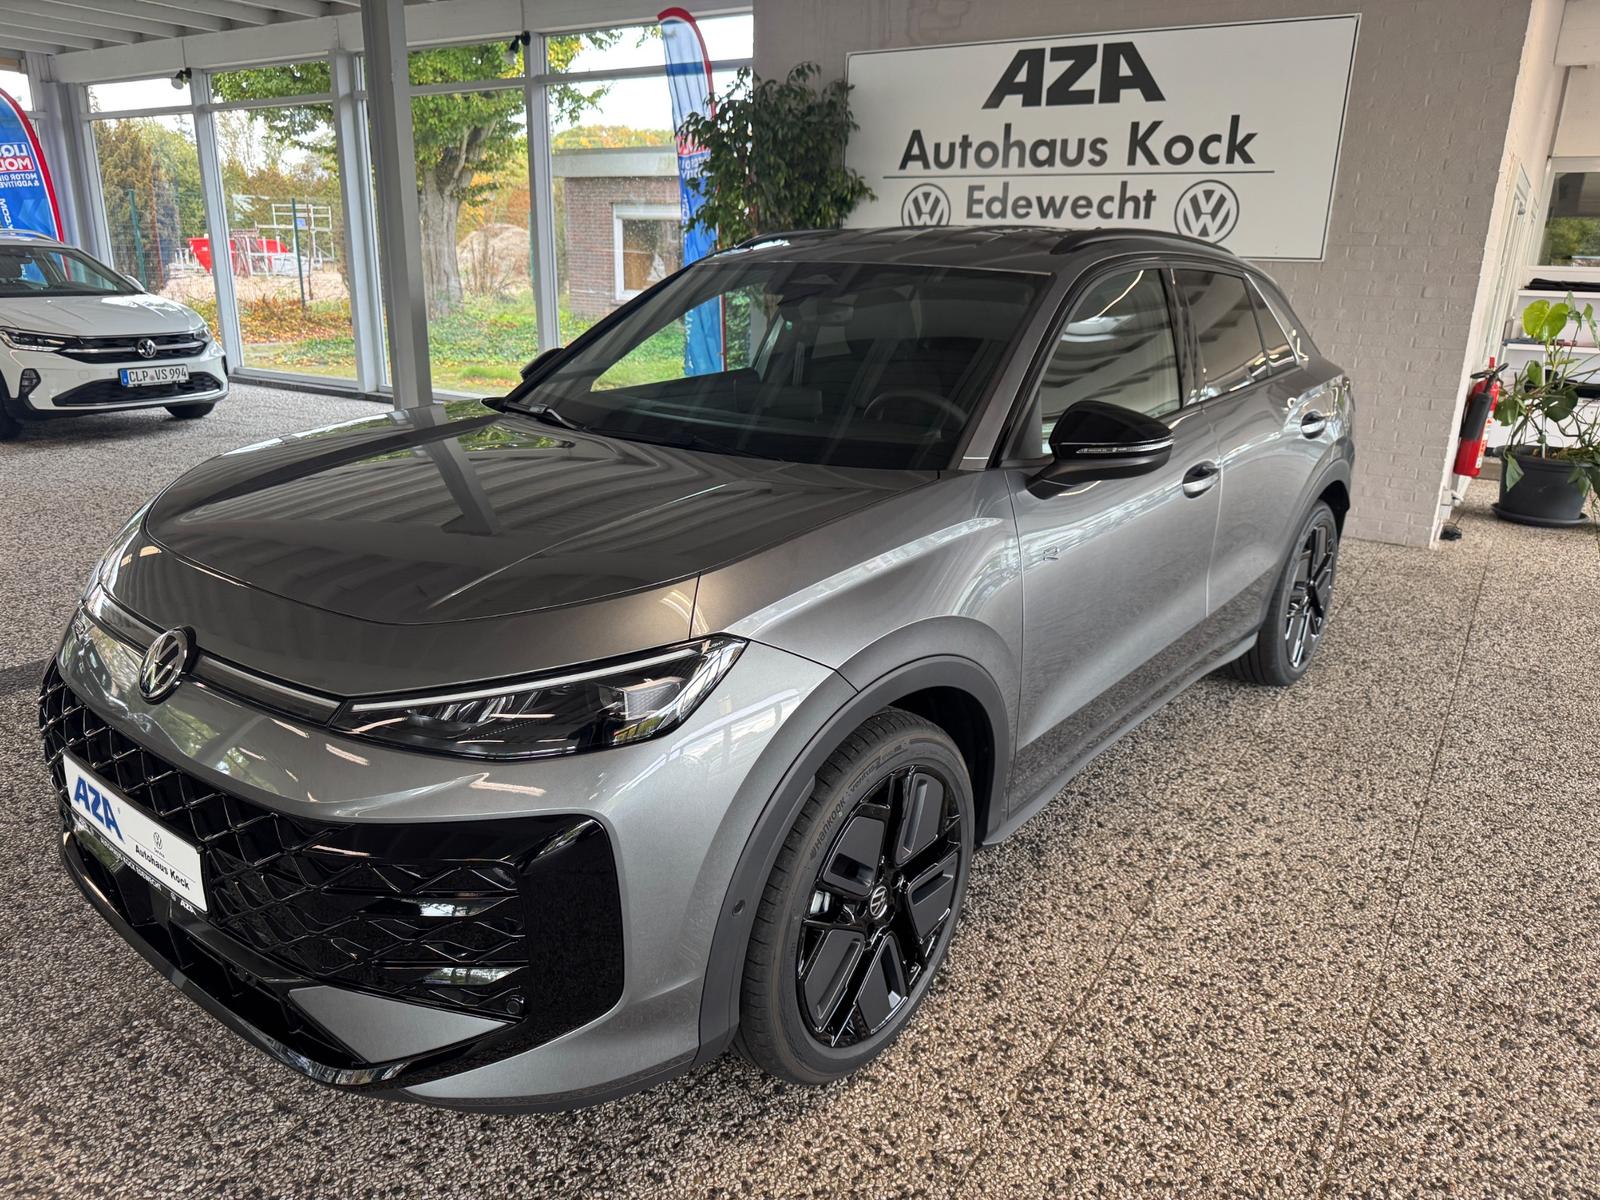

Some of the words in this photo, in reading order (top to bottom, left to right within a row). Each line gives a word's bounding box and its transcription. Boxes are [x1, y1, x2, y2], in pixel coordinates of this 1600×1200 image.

[981, 41, 1166, 109] AZA
[899, 122, 1108, 171] Autohaus
[1127, 114, 1258, 167] Kock
[966, 181, 1157, 220] Edewecht
[129, 370, 149, 383] CLP
[155, 368, 168, 380] VS
[169, 367, 187, 380] 994
[73, 776, 126, 844] AZA
[815, 796, 846, 848] Hankook
[135, 844, 169, 875] Autohaus
[169, 870, 191, 891] Kock
